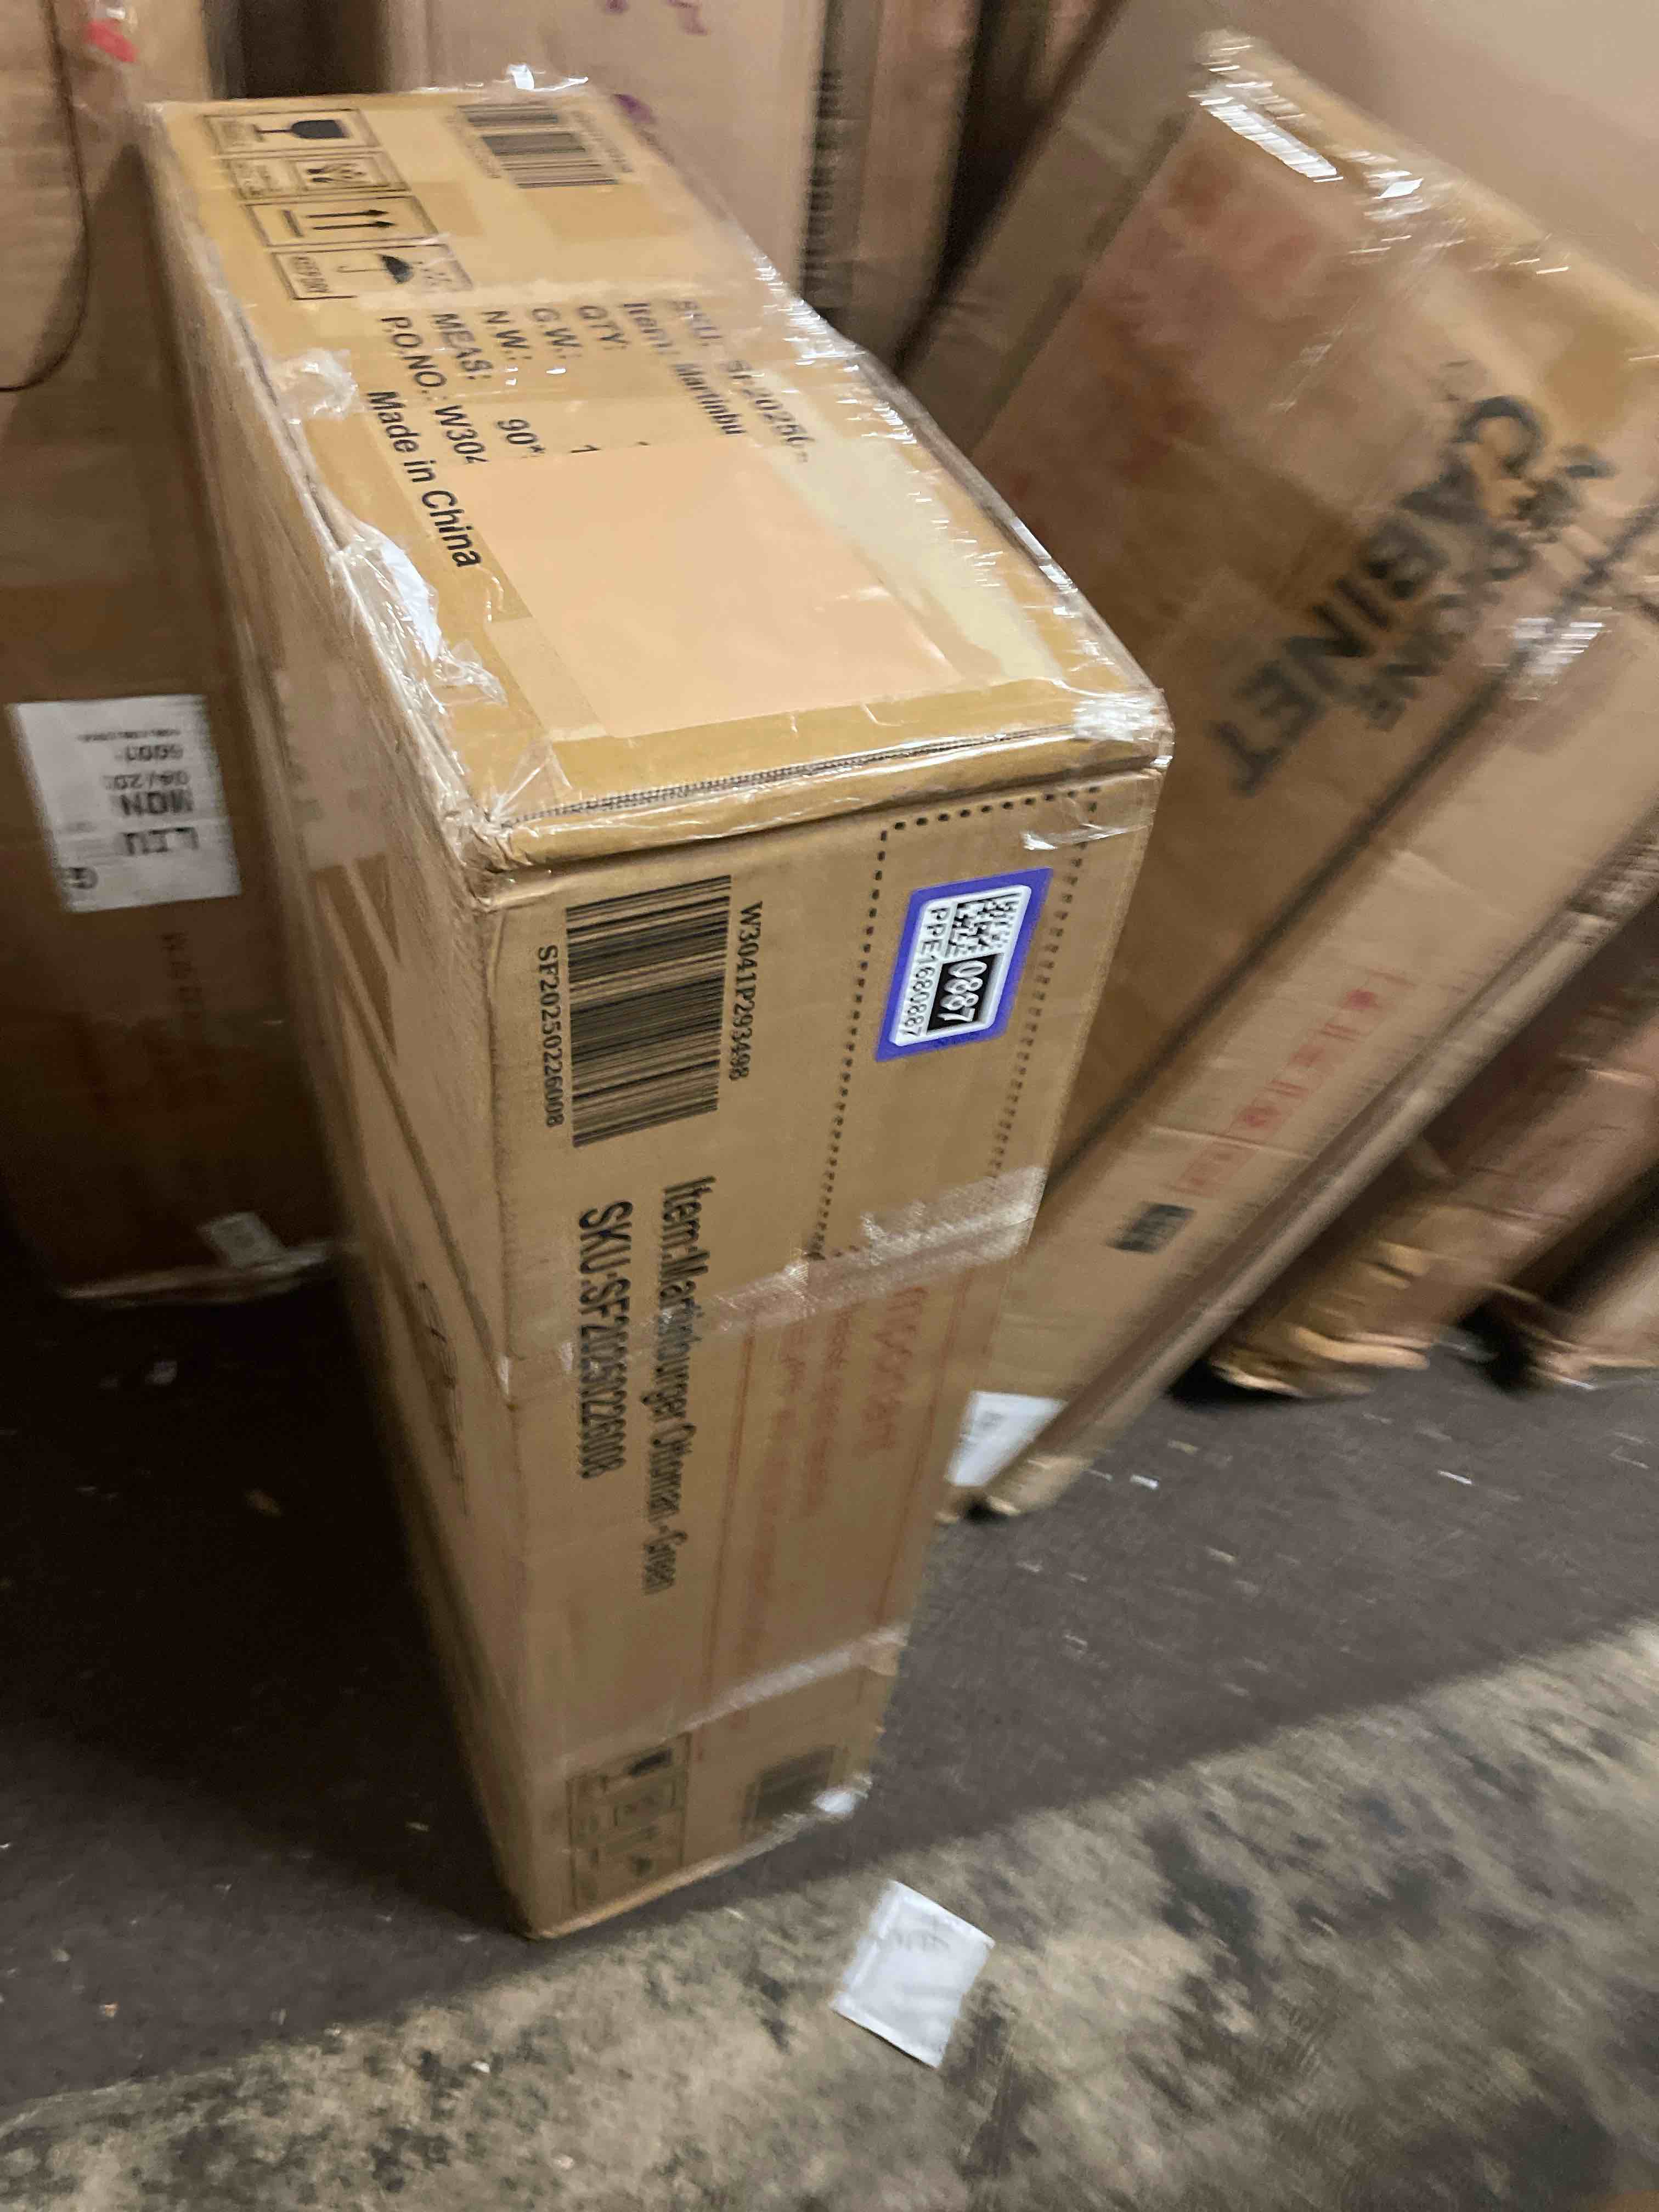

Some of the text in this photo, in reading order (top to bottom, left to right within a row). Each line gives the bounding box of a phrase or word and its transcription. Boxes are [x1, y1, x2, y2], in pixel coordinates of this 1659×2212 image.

[431, 313, 493, 380] MEAS:
[368, 391, 482, 568] Made in China
[1205, 394, 1546, 799] CABINET
[538, 945, 565, 1127] SF20250226008
[904, 907, 949, 1036] PPE1680887
[937, 960, 987, 1022] 0887
